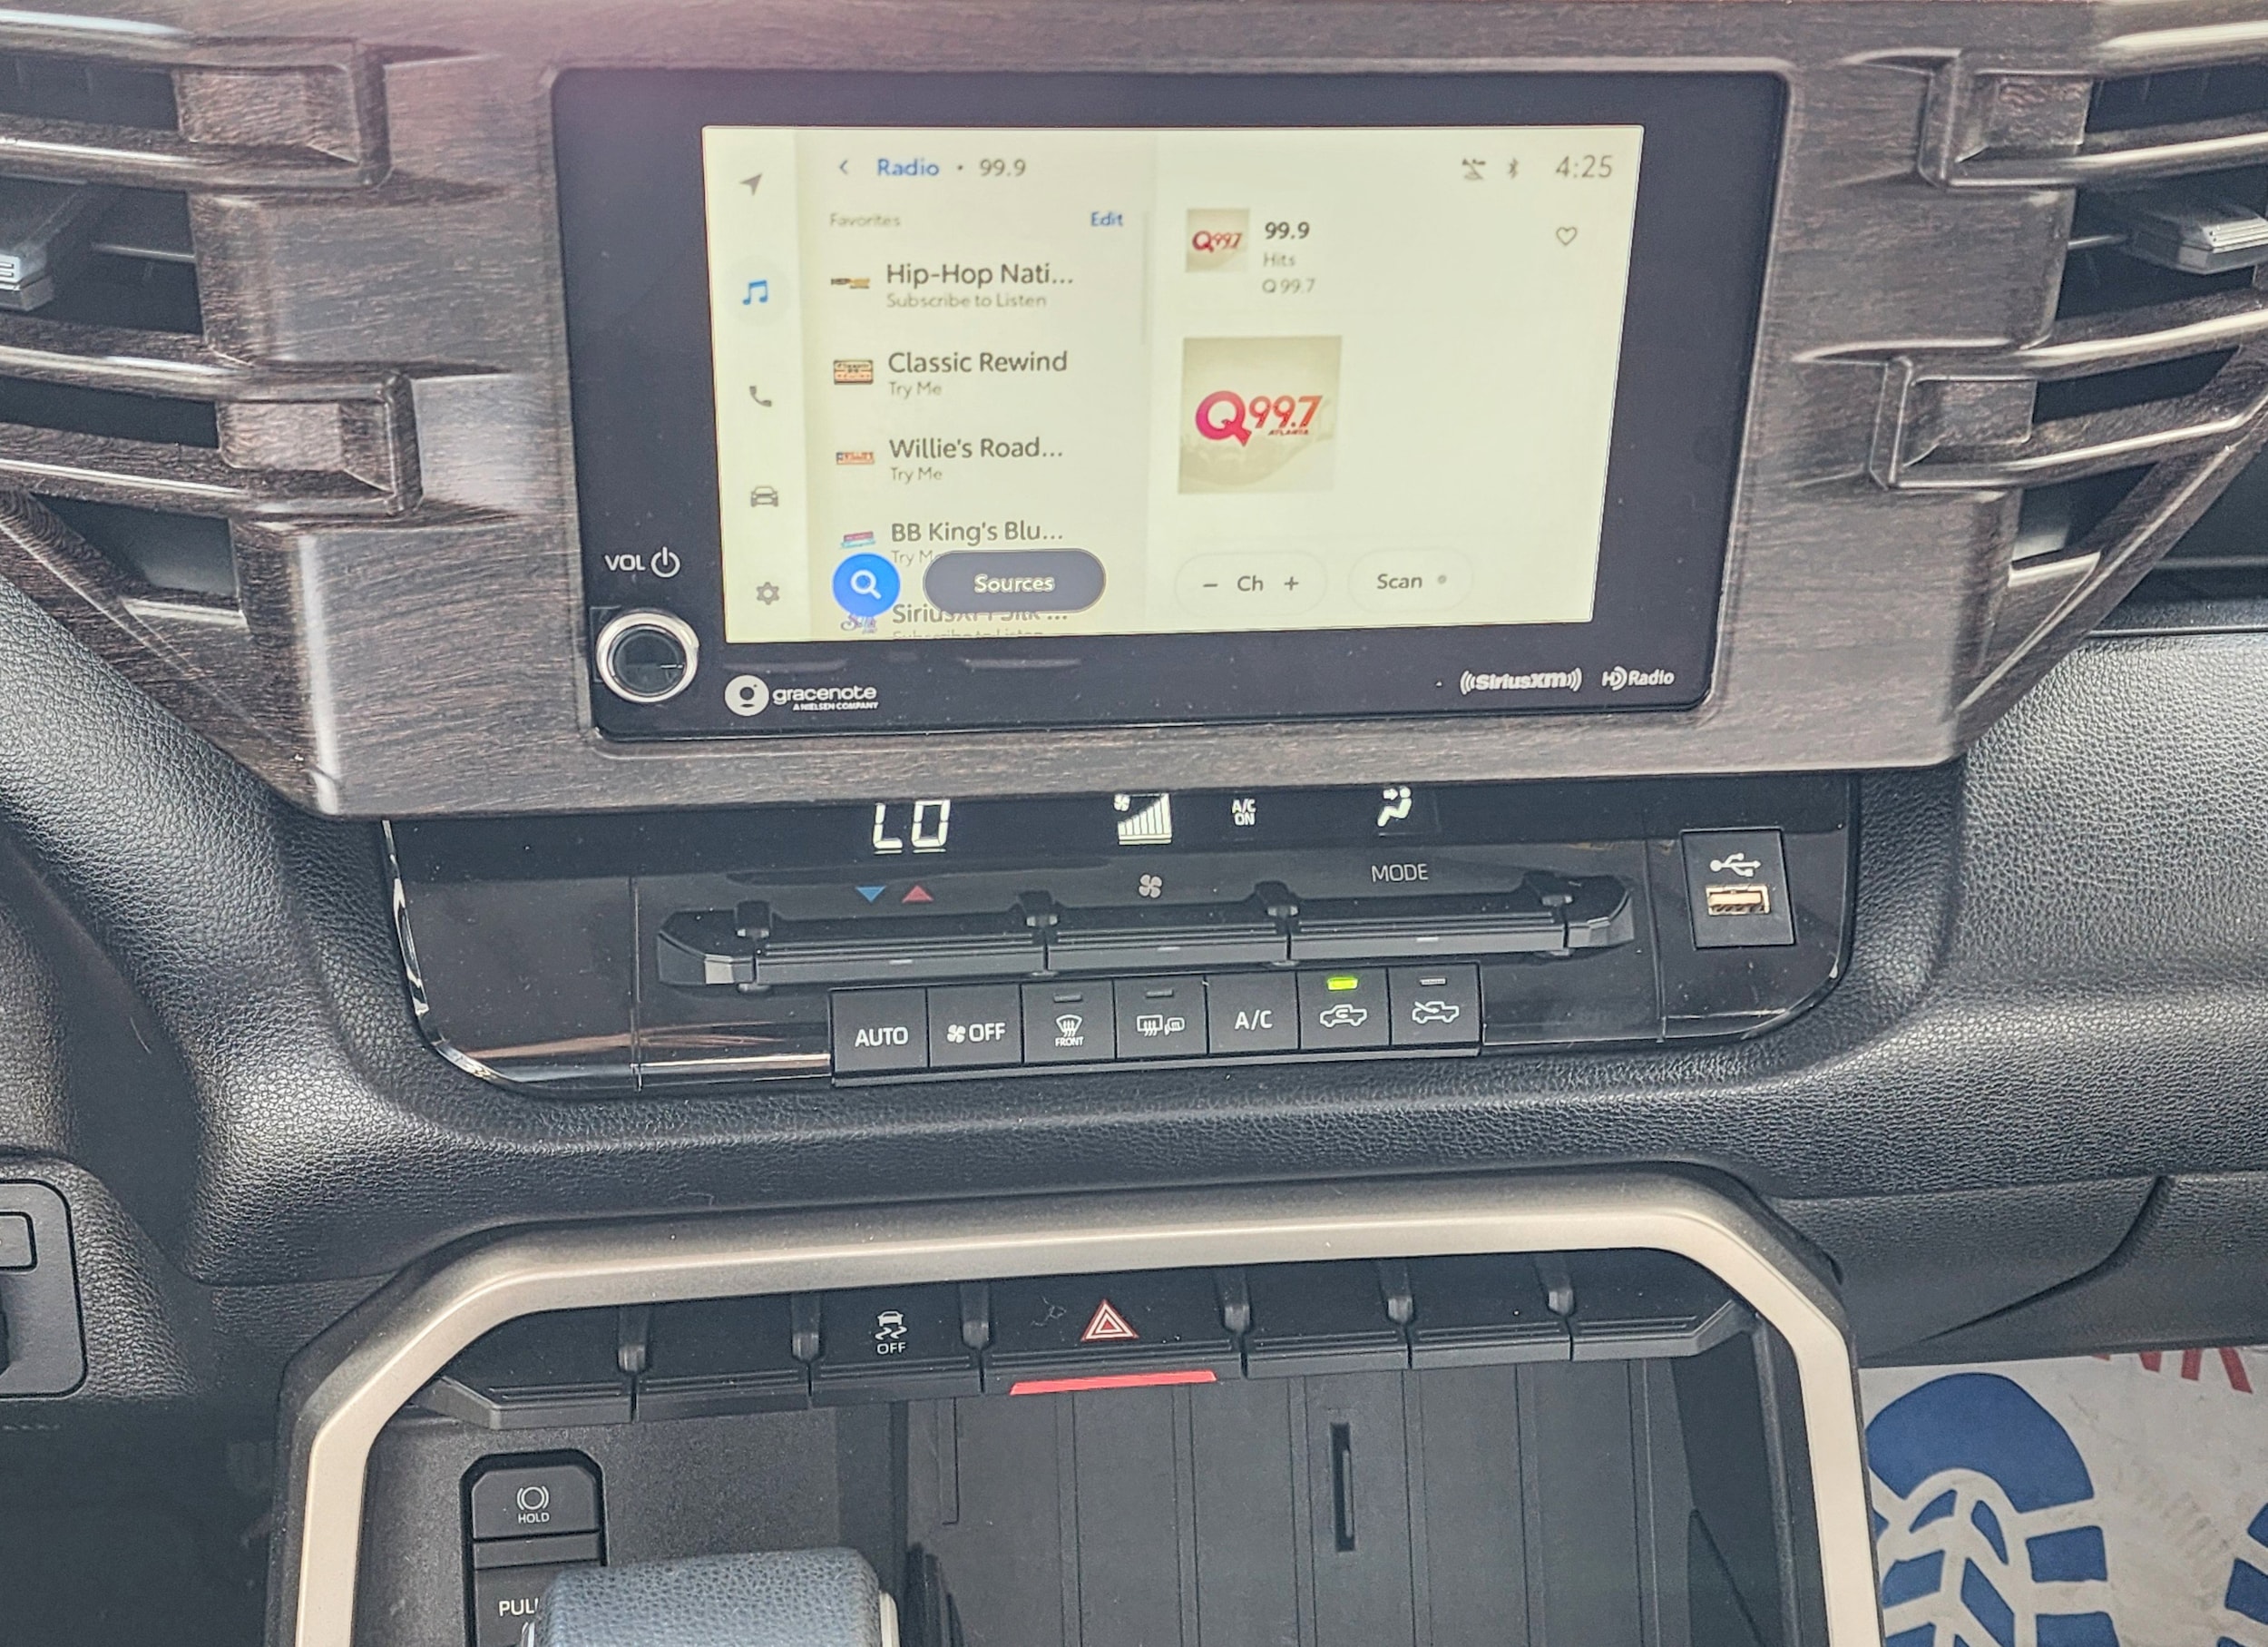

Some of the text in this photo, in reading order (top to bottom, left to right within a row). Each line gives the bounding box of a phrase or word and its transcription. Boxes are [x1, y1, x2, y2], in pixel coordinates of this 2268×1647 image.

[876, 158, 1027, 177] Radio 99.9
[1555, 155, 1612, 178] 4:25
[829, 212, 901, 228] Favorites
[1090, 211, 1124, 227] Edit
[1265, 221, 1310, 240] 99.9
[1262, 252, 1296, 268] Hits
[886, 263, 994, 289] Hip-Hop
[1000, 262, 1074, 285] Nati...
[1262, 278, 1316, 294] Q 99.7
[886, 292, 1047, 309] Subscribe to Listen
[888, 350, 1068, 374] Classic Rewind
[889, 381, 943, 398] Try Me
[1195, 390, 1324, 447] Q99.7
[889, 436, 1063, 459] Willie's Road...
[891, 466, 943, 485] Try Me
[892, 523, 922, 543] BB
[929, 522, 998, 546] King's
[1004, 520, 1064, 542] Blu...
[604, 554, 646, 571] VOL
[891, 549, 914, 566] Try
[974, 573, 1055, 593] Sources
[1237, 575, 1264, 593] Ch
[1376, 574, 1422, 590] Scan
[1628, 670, 1675, 686] Radio
[772, 685, 877, 705] gracenote
[836, 701, 879, 711] COMPANY
[1231, 799, 1256, 814] A/C
[1235, 812, 1256, 826] ON
[1371, 863, 1429, 883] MODE
[1235, 1009, 1273, 1031] A/C
[855, 1026, 909, 1048] AUTO
[968, 1022, 1007, 1043] OFF
[1054, 1035, 1085, 1048] FRONT
[876, 1341, 906, 1355] OFF
[518, 1512, 550, 1524] HOLD
